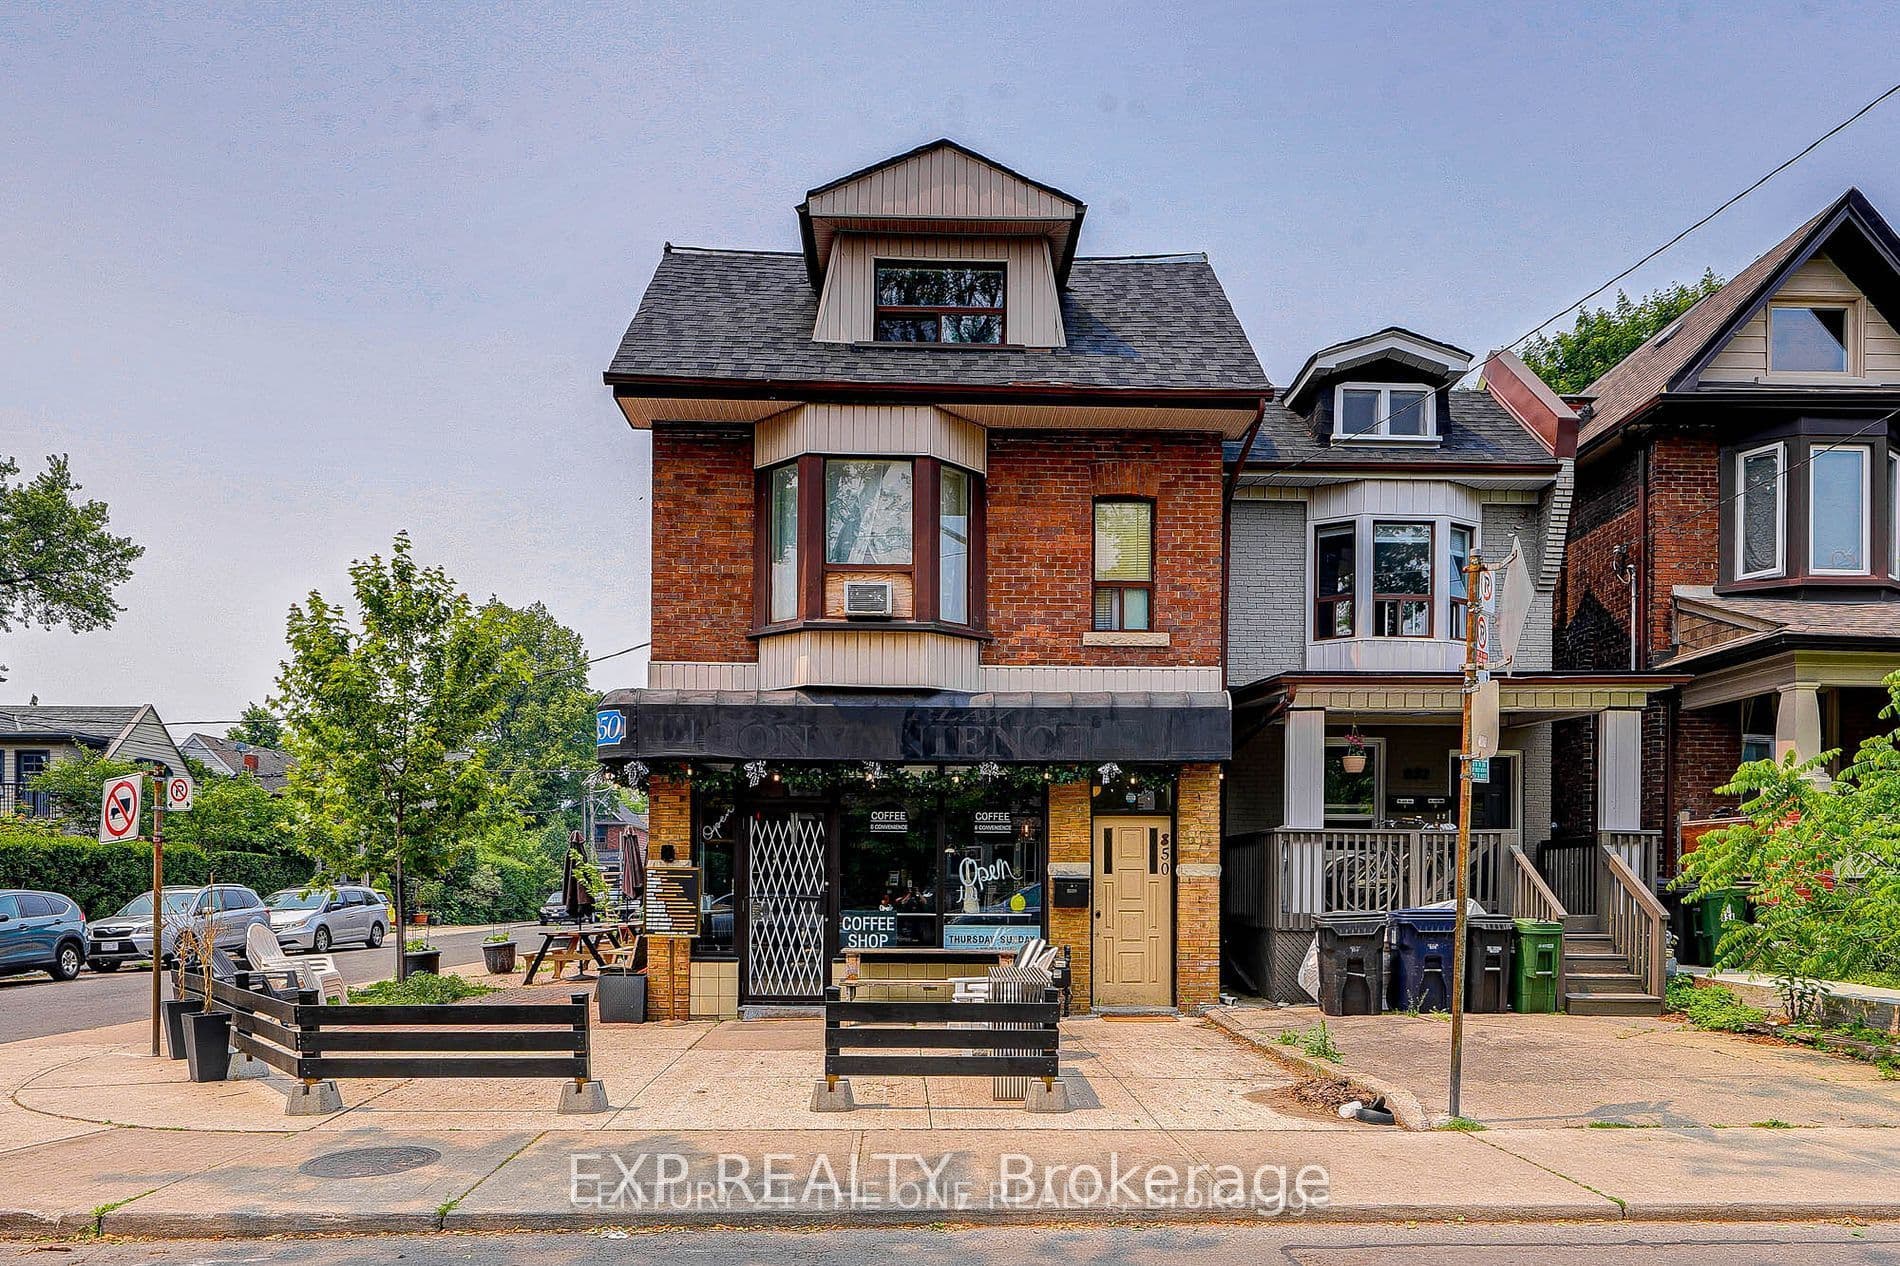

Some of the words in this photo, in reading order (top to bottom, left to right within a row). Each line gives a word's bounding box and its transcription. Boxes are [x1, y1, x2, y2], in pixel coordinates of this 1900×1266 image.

[871, 811, 907, 821] COFFEE
[975, 812, 1011, 821] COFFEE
[1161, 833, 1169, 875] 850
[959, 857, 1023, 890] Open
[842, 916, 895, 931] COFFEE
[848, 934, 889, 949] SHOP
[950, 935, 995, 944] THURSDAY
